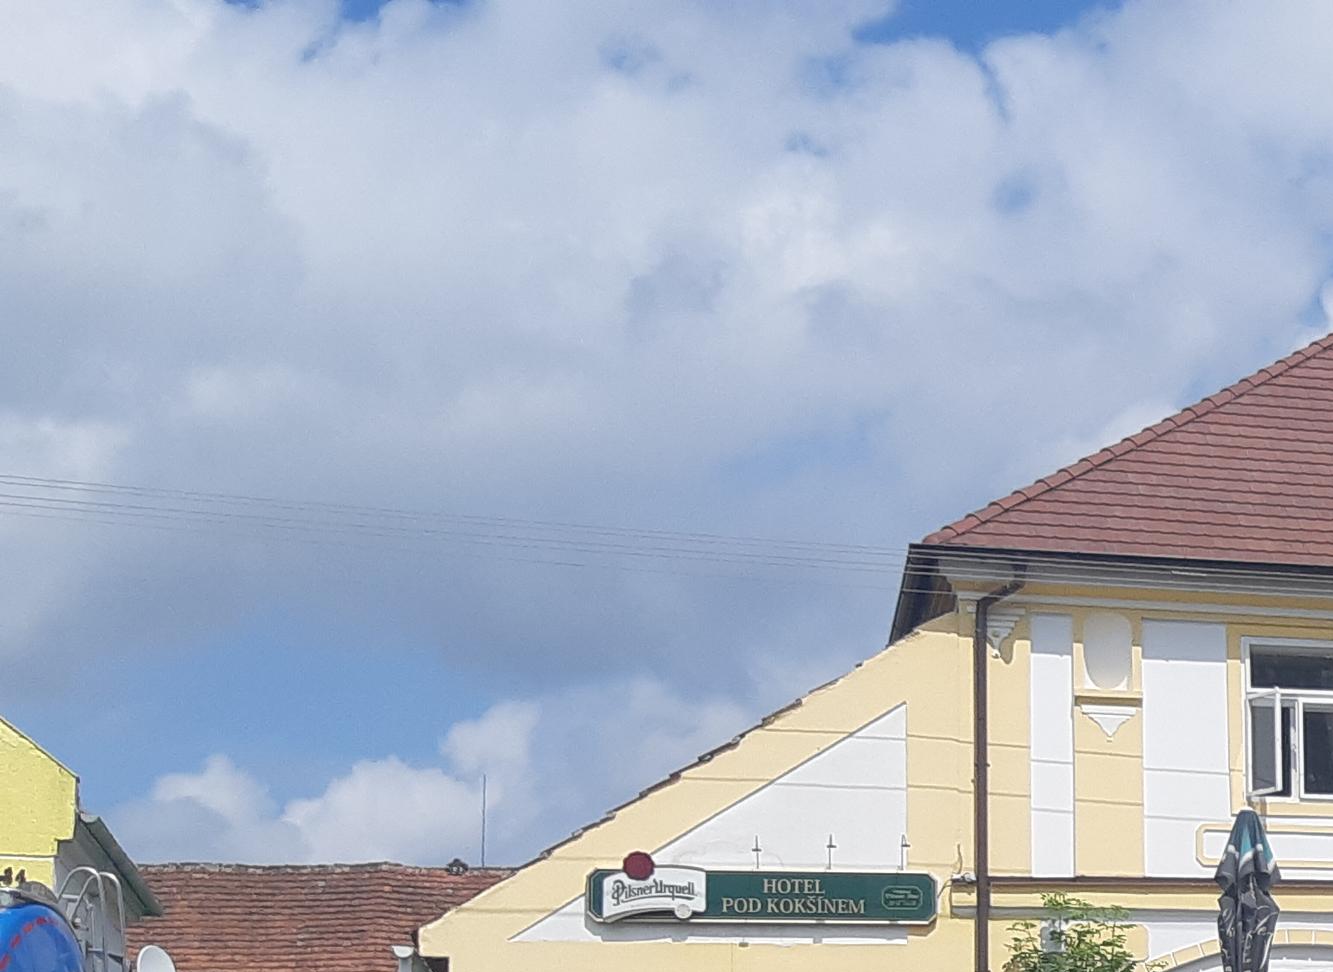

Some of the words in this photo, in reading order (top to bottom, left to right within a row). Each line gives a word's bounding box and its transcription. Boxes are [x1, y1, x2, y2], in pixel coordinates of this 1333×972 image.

[612, 880, 655, 906] Pilsner
[653, 878, 698, 900] Urquell
[762, 878, 825, 894] HOTEL
[721, 897, 761, 913] POD
[766, 895, 865, 914] KOKŠÍNEM
